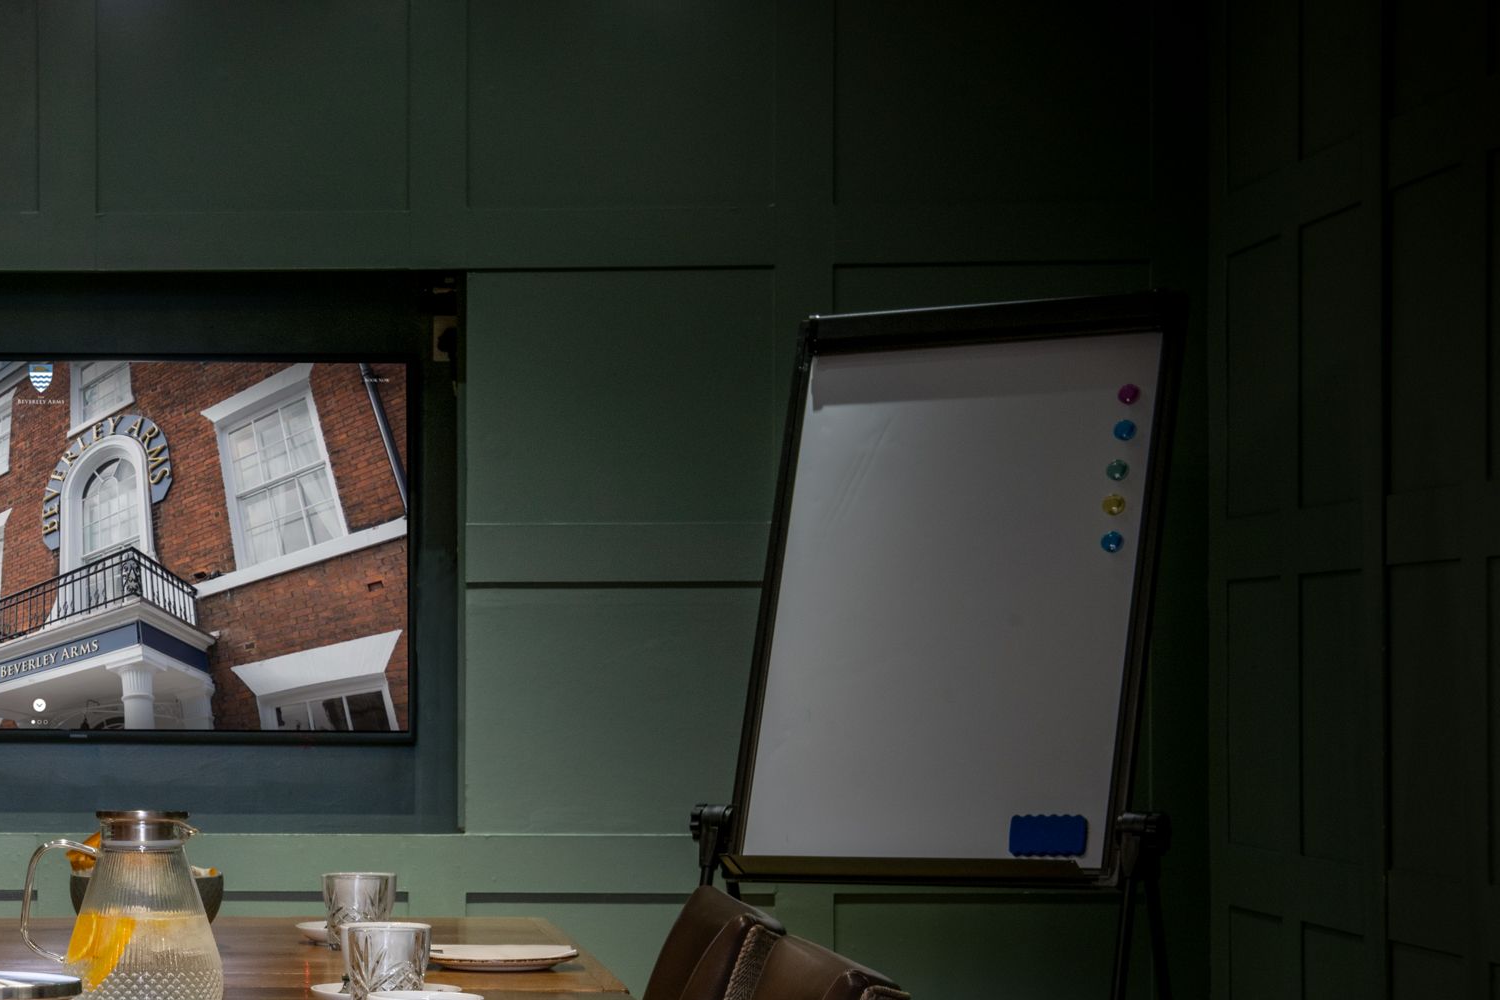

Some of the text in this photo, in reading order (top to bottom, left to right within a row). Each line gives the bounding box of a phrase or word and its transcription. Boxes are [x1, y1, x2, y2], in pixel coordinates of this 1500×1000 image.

[42, 415, 171, 536] BEVERLEY ARMS
[0, 651, 58, 678] BEVERLEY
[61, 639, 99, 660] ARMS
